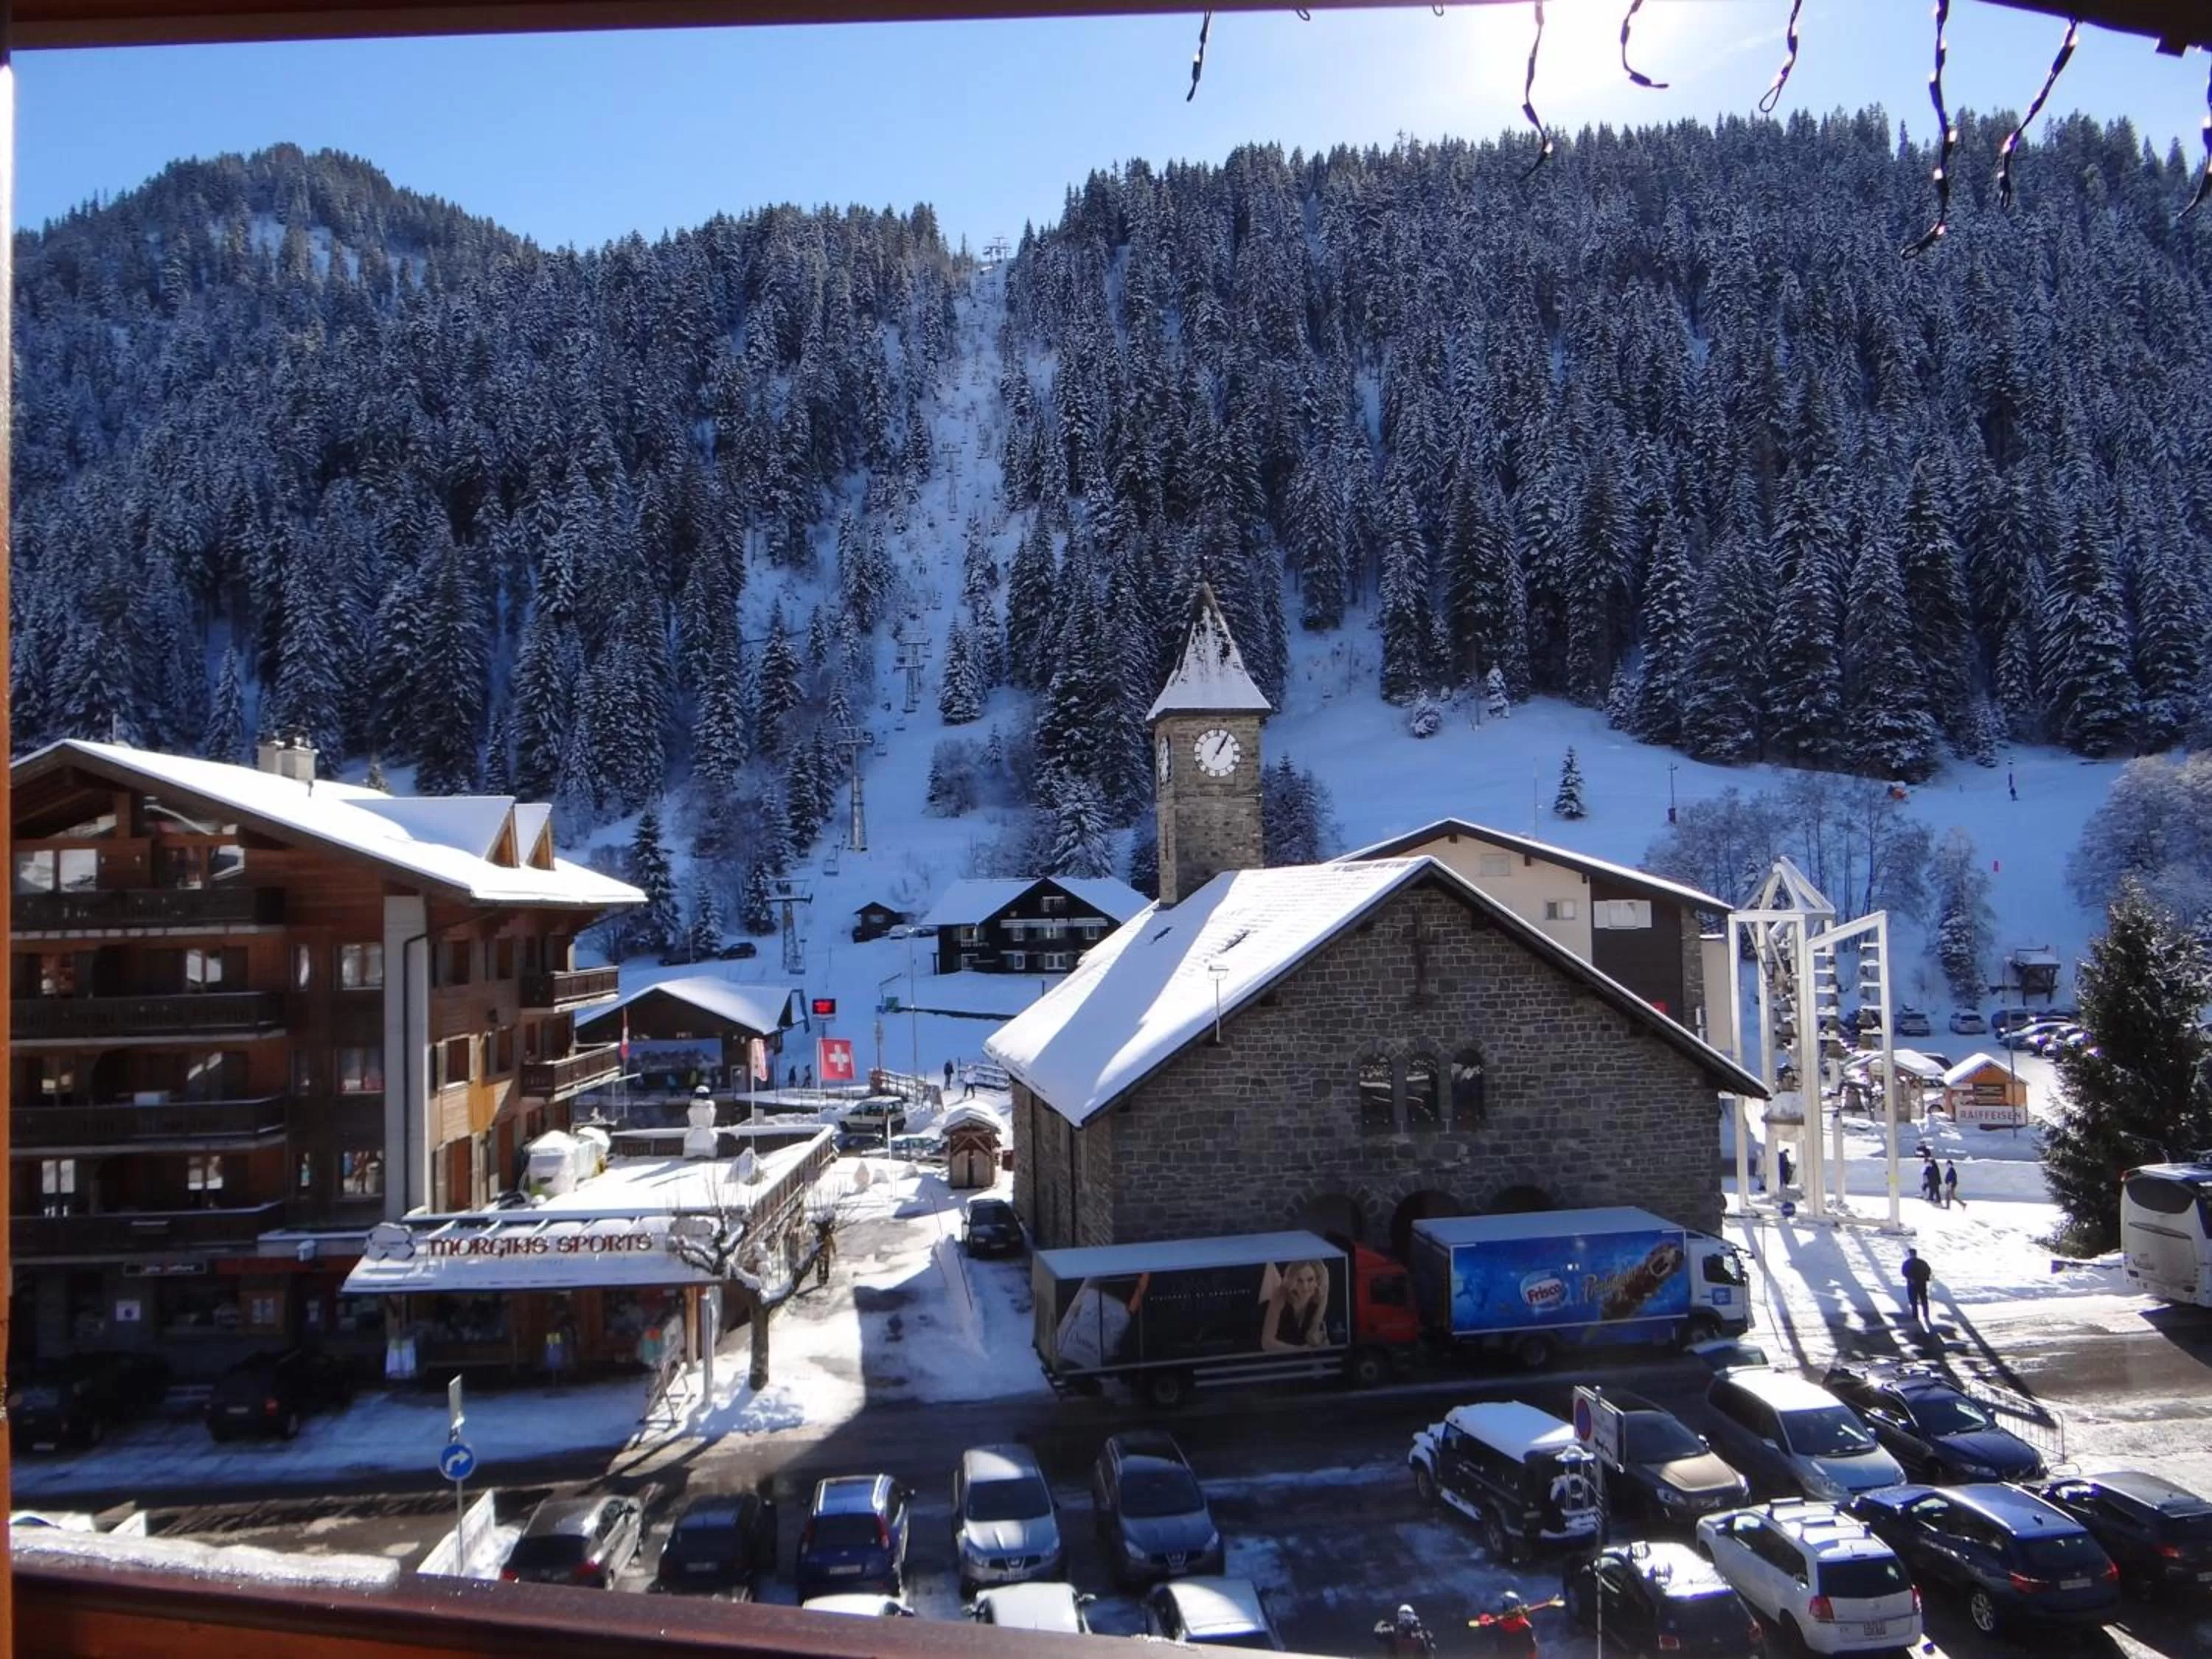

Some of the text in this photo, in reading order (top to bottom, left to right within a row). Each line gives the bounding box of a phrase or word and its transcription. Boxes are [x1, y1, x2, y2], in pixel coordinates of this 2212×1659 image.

[1960, 1110, 2022, 1120] RAIFFEISEN
[429, 1232, 653, 1257] MORGINS SPORTS
[1527, 1284, 1562, 1303] Frisco
